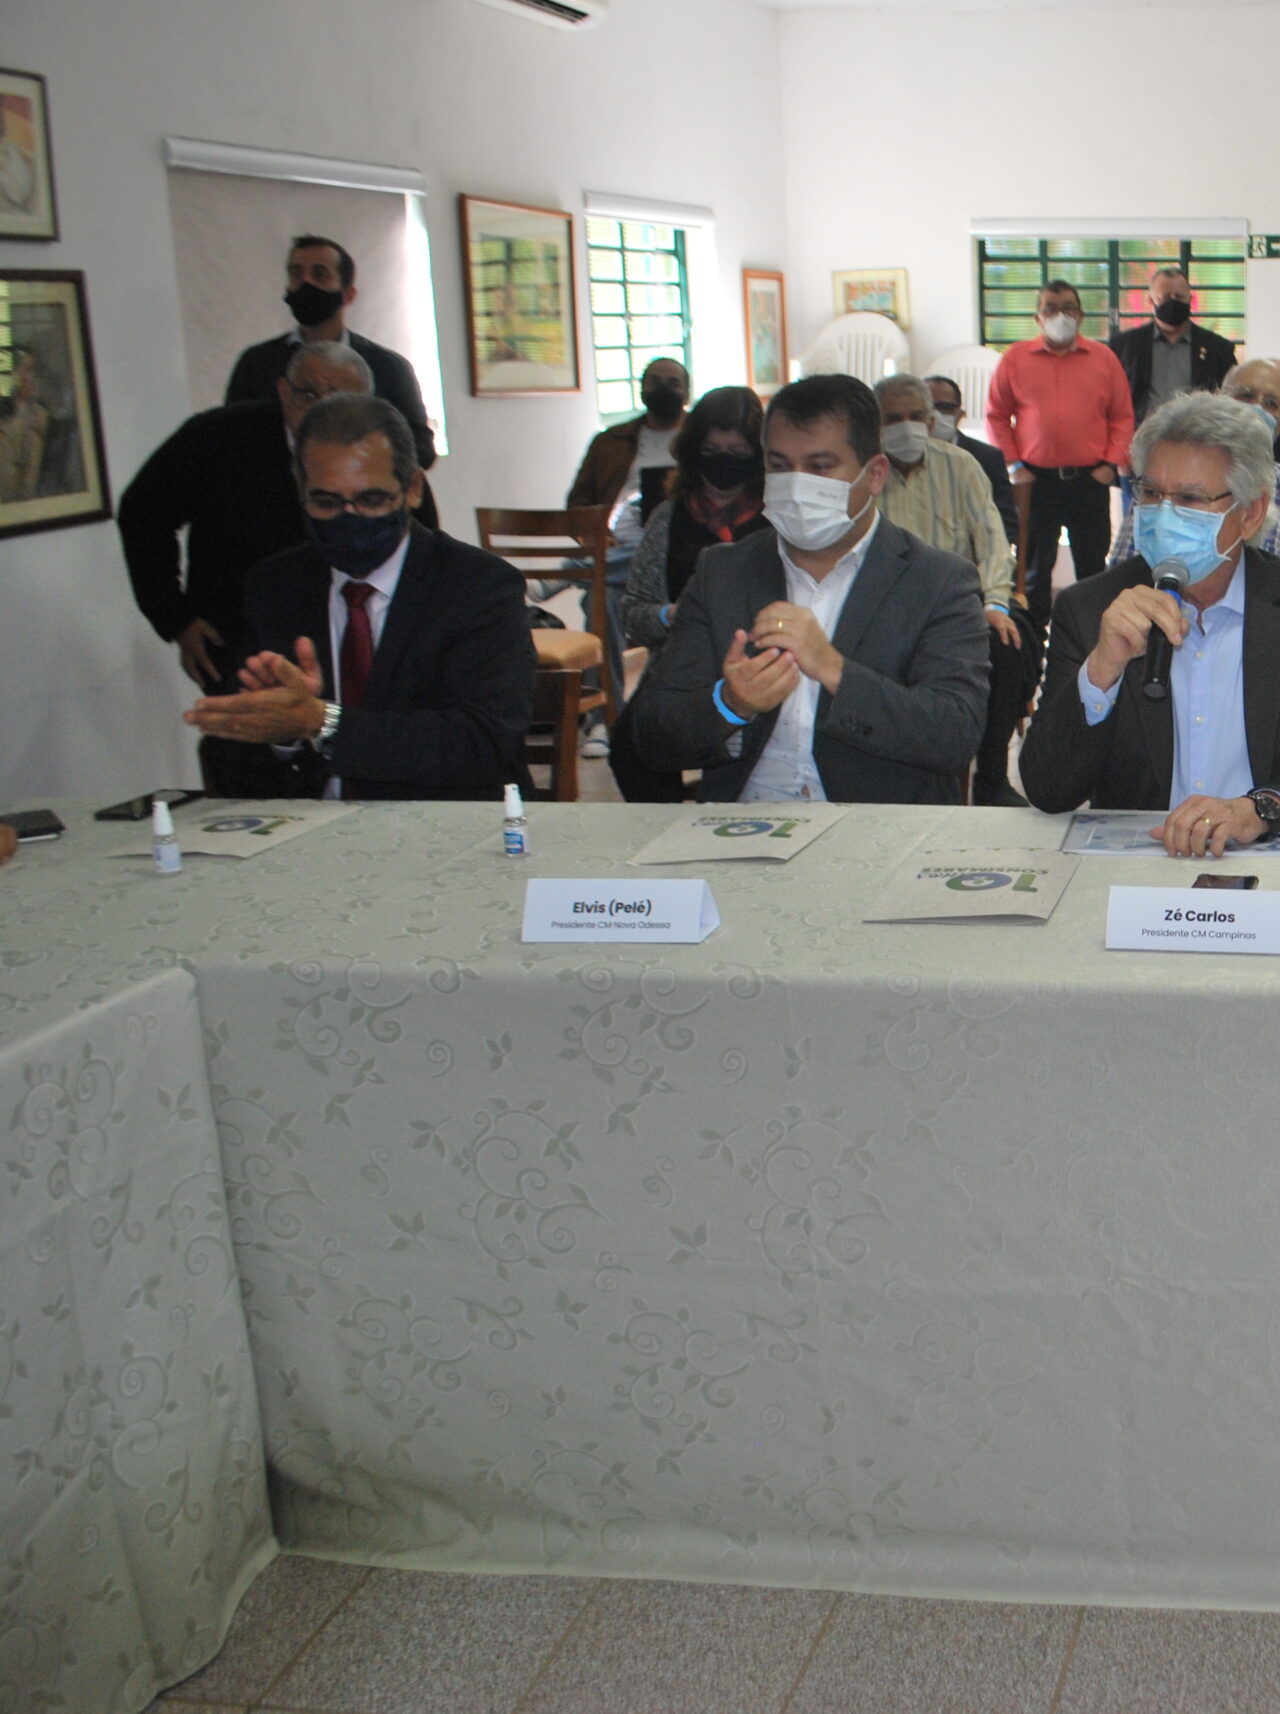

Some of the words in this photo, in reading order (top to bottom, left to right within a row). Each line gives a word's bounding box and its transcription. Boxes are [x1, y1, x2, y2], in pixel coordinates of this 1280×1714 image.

[572, 901, 606, 914] Elvis
[609, 899, 652, 916] (Pelé)
[1164, 908, 1183, 922] Zé
[1185, 910, 1236, 923] Carlos
[551, 920, 596, 929] Presidente
[597, 920, 612, 929] CM
[614, 921, 636, 929] Nova
[637, 921, 671, 929] Odessa
[1141, 928, 1190, 938] Presidente
[1191, 930, 1207, 938] CM
[1208, 930, 1257, 941] Campinas
